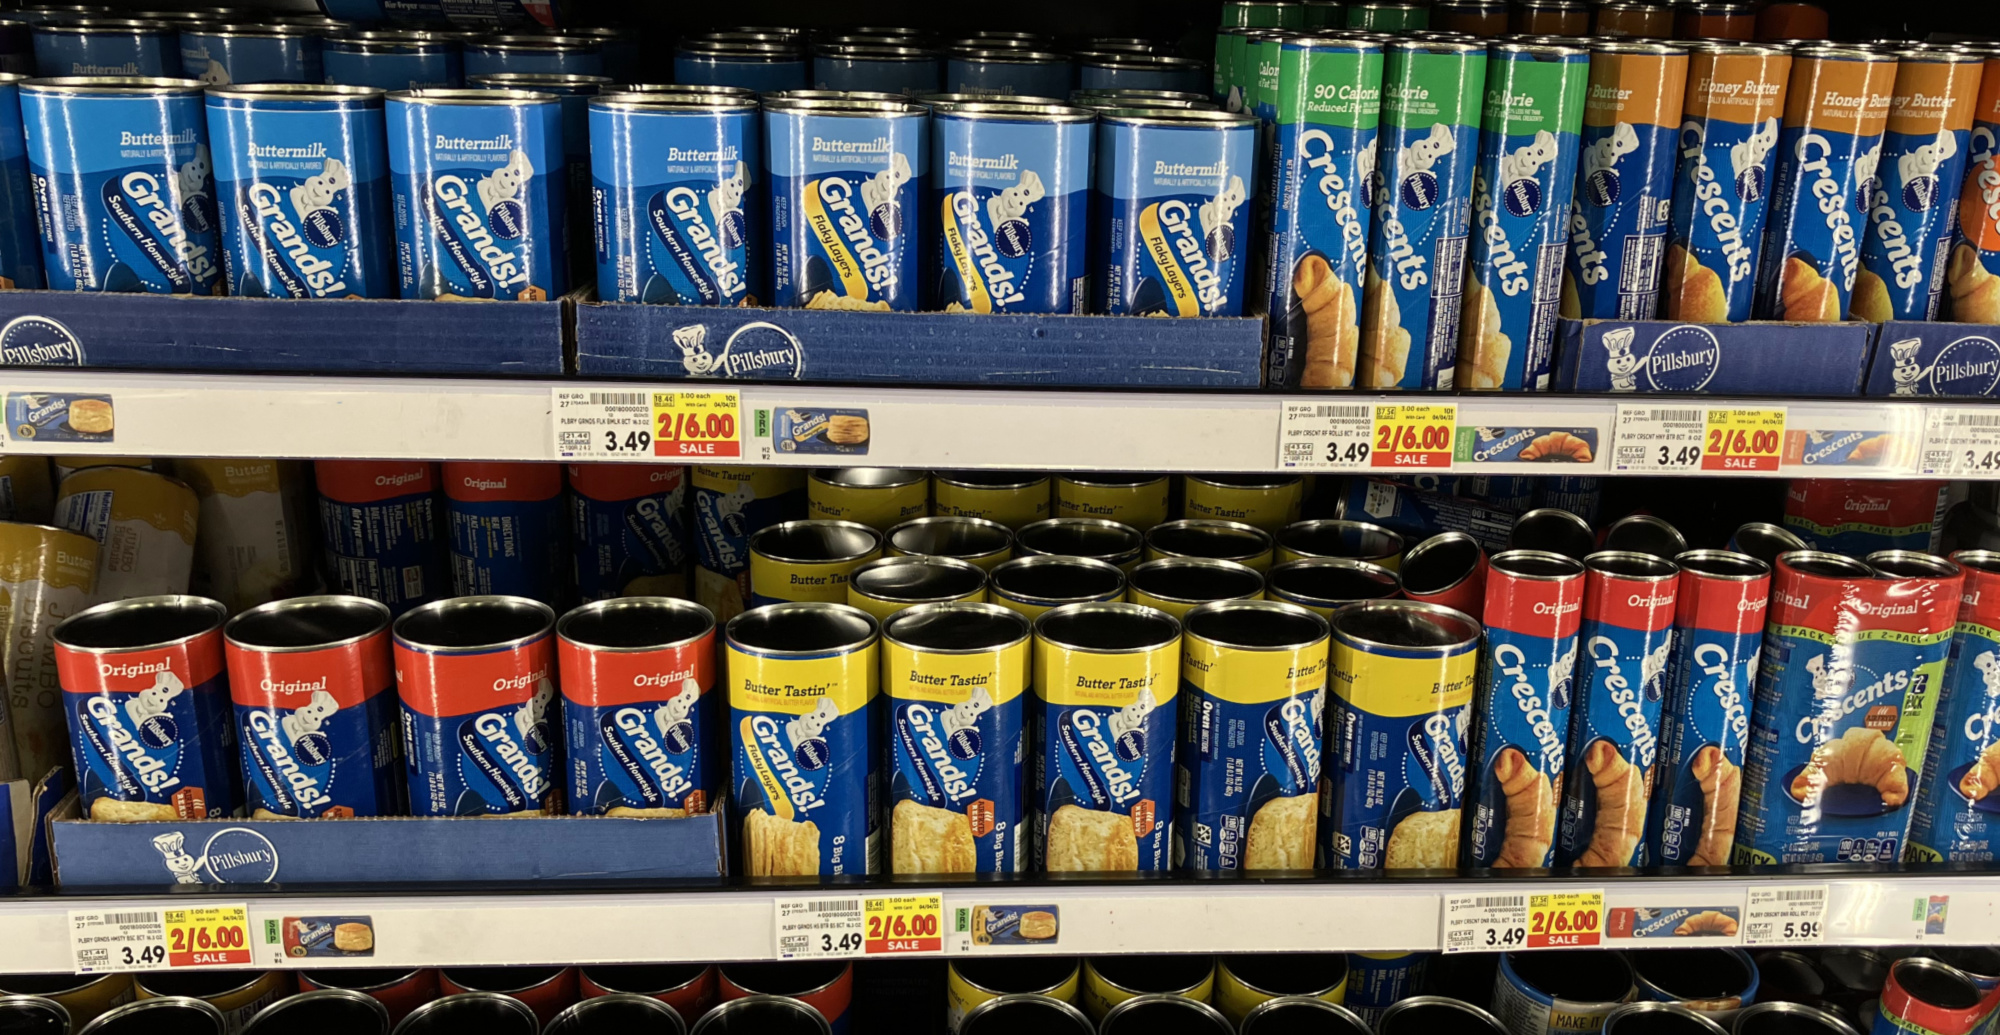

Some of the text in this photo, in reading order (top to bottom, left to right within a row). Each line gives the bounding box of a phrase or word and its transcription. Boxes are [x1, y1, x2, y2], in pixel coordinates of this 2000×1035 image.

[1314, 84, 1378, 99] 90 Calorie
[1385, 83, 1429, 100] Calorie
[1698, 78, 1779, 95] Honey Butter
[1308, 102, 1347, 113] Reduced
[1488, 90, 1534, 107] Calorie
[1823, 92, 1867, 107] Honey
[120, 128, 196, 146] Buttermilk
[435, 135, 512, 149] Buttermilk
[812, 137, 891, 152] Buttermilk
[247, 142, 326, 158] Buttermilk
[668, 146, 738, 161] Buttermilk
[949, 152, 1019, 169] Buttermilk
[1154, 161, 1229, 176] Buttermilk
[39, 177, 49, 210] Oven
[1680, 121, 1751, 281] Crescents
[109, 195, 143, 238] Southern
[122, 171, 217, 283] Grands!
[249, 183, 346, 297] Grands!
[435, 175, 526, 288] Grands!
[666, 187, 746, 297] Grands!
[653, 209, 712, 300] Southern Homestyle
[813, 215, 852, 278] Flaky Layers
[948, 228, 977, 291] Flaky Layers
[1150, 237, 1186, 298] Flaky Layers
[4, 342, 73, 362] Pillsbury
[730, 349, 793, 373] Pillsbury
[1652, 348, 1715, 374] Pillsbury
[1937, 360, 1999, 383] Pillsbury
[658, 413, 734, 441] 2/6.00
[1378, 425, 1450, 452] 2/6.00
[606, 431, 650, 451] 3.49
[680, 443, 714, 453] SALE
[1326, 442, 1370, 462] 3.49
[1474, 428, 1536, 461] Crescents
[1708, 429, 1778, 455] 2/6.00
[1804, 431, 1863, 465] Crescents
[1395, 455, 1428, 464] SALE
[1658, 446, 1700, 465] 3.49
[1725, 459, 1757, 468] SALE
[464, 477, 507, 490] Original
[815, 502, 845, 516] Tastin'
[1083, 503, 1117, 515] Tastin'
[1189, 500, 1249, 518] Butter Tastin'
[790, 574, 827, 585] Butter
[1533, 597, 1580, 616] Original
[1859, 600, 1918, 616] Original
[100, 657, 170, 678] Original
[493, 663, 547, 691] Original
[634, 664, 694, 687] Original
[910, 671, 992, 686] Butter Tastin'
[1286, 665, 1317, 679] Butter
[260, 676, 327, 695] Original
[744, 679, 830, 696] Butter Tastin'
[1076, 676, 1116, 690] Butter
[1431, 677, 1463, 694] Butter
[1494, 643, 1564, 775] Crescents
[1588, 635, 1656, 767] Crescents
[1202, 701, 1213, 730] Oven
[1346, 712, 1356, 739] Oven
[80, 713, 105, 752] Southern
[250, 711, 331, 809] Grands!
[475, 713, 550, 798] Grands!
[603, 726, 657, 802] Southern Homestyle
[615, 708, 692, 798] Grands!
[752, 715, 825, 812] Grands!
[907, 704, 977, 801] Grands!
[1061, 724, 1104, 804] Southern Homestyle
[1072, 709, 1140, 804] Grands!
[463, 734, 519, 806] Southern Homestyle
[748, 744, 780, 801] Flaky Layers
[914, 757, 939, 802] Homestyle
[209, 807, 221, 817] 8
[994, 822, 1006, 850] 8 Big
[1153, 820, 1164, 850] 8 Big
[210, 849, 271, 872] Pillsbury
[831, 835, 845, 863] 8 Big
[869, 914, 937, 940] 2/6.00
[1532, 910, 1598, 934] 2/6.00
[1633, 907, 1689, 938] Crescents
[1783, 922, 1819, 939] 5.99
[171, 926, 244, 952] 2/6.00
[822, 933, 862, 951] 3.49
[888, 941, 919, 950] SALE
[1486, 928, 1525, 945] 3.49
[1549, 935, 1579, 944] SALE
[122, 946, 165, 964] 3.49
[193, 953, 227, 963] SALE
[1556, 1015, 1599, 1028] MAKE IT
